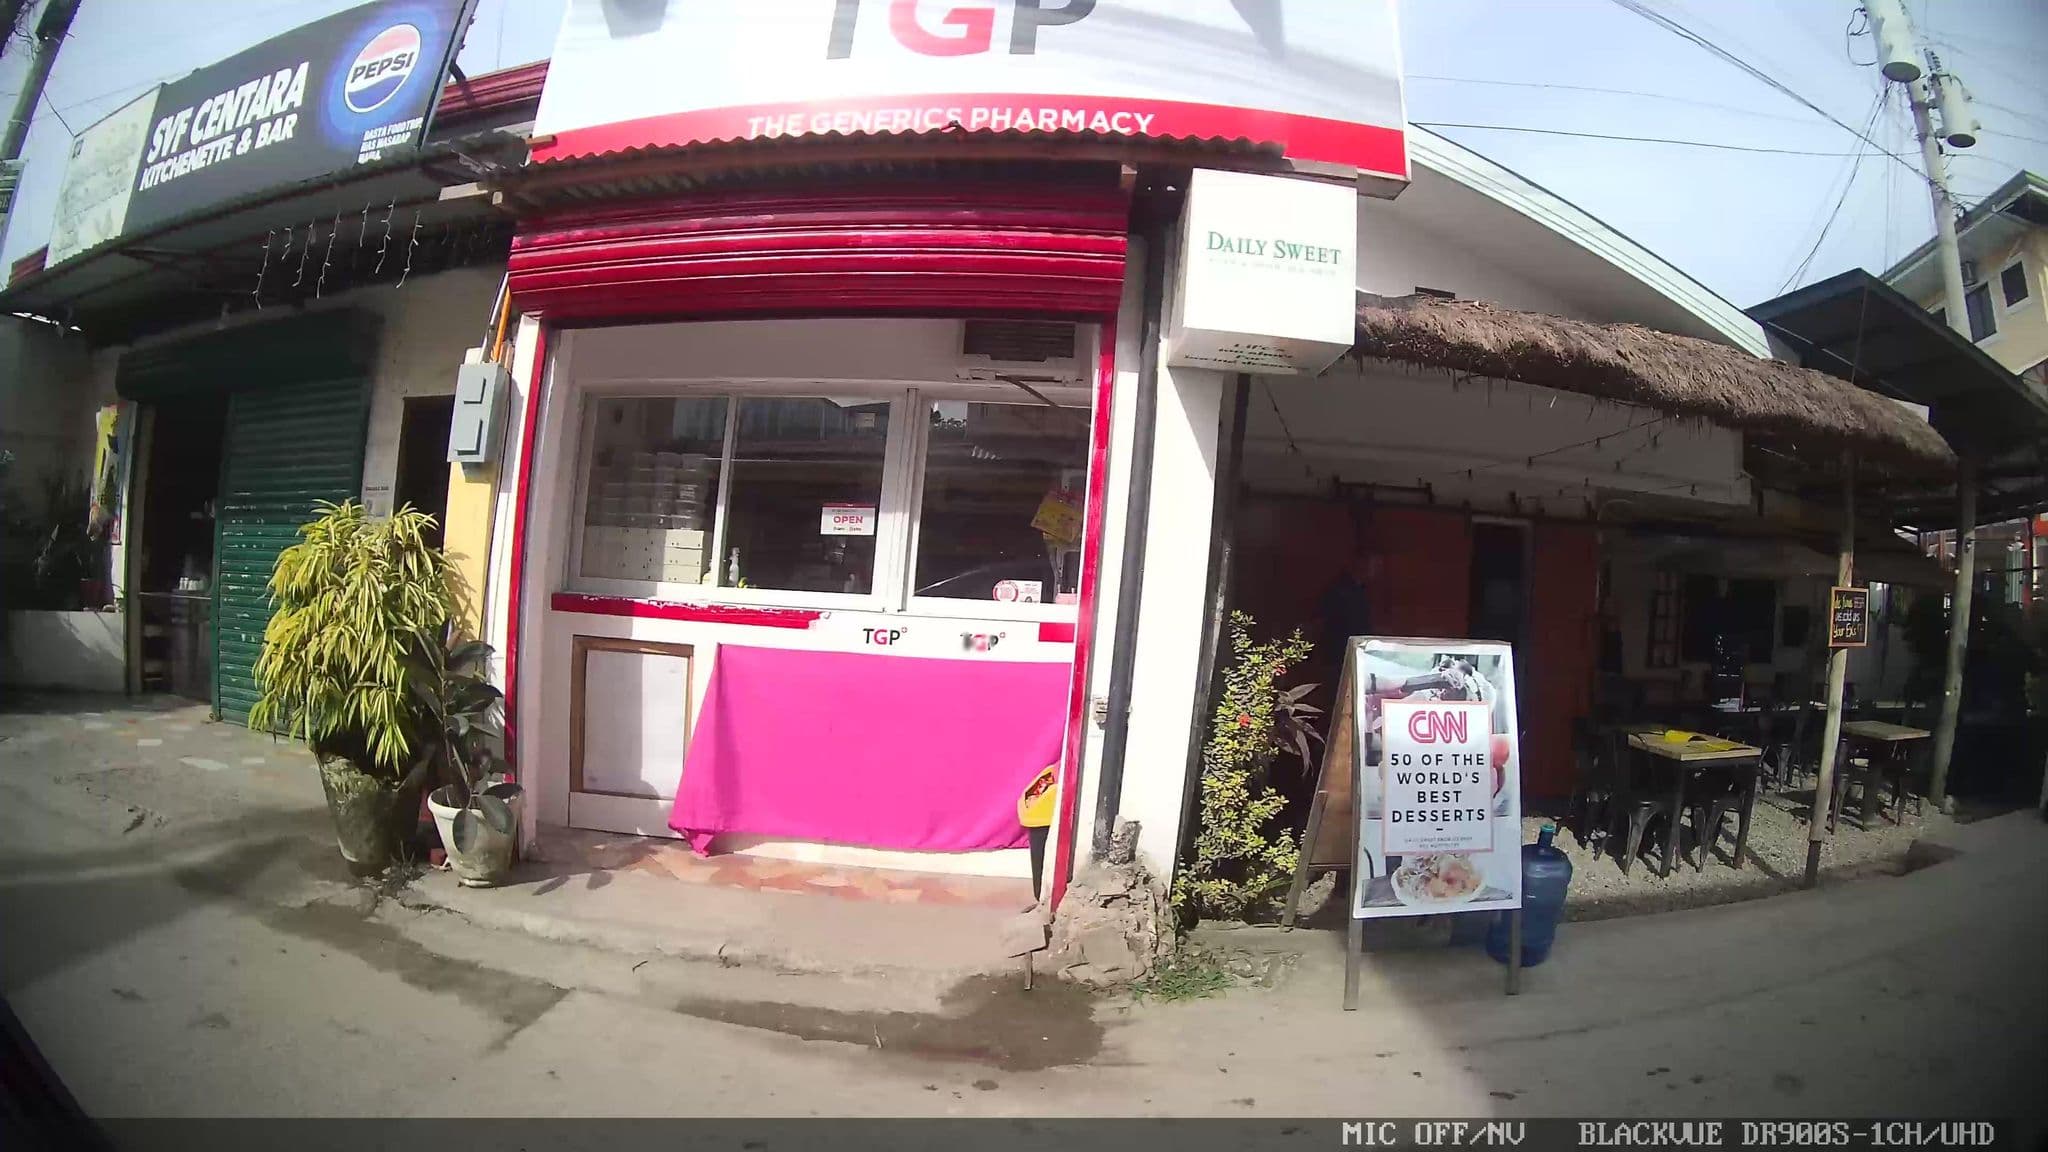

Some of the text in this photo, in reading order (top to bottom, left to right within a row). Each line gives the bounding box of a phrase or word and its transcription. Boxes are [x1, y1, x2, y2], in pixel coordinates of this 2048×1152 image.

[351, 52, 415, 83] PEPSI
[190, 62, 309, 145] CENTARA
[747, 107, 1156, 140] THE GENERICS PHARMACY
[139, 113, 298, 191] KITCHENETTE & BAR
[1206, 231, 1342, 265] DAILY SWEET
[833, 516, 864, 524] OPEN
[863, 628, 901, 645] TGP
[1408, 710, 1467, 744] CNN
[1391, 753, 1485, 766] 50 OF THE
[1397, 772, 1480, 785] WORLD'S
[1417, 791, 1462, 803] BEST
[1392, 809, 1485, 823] DESSERTS
